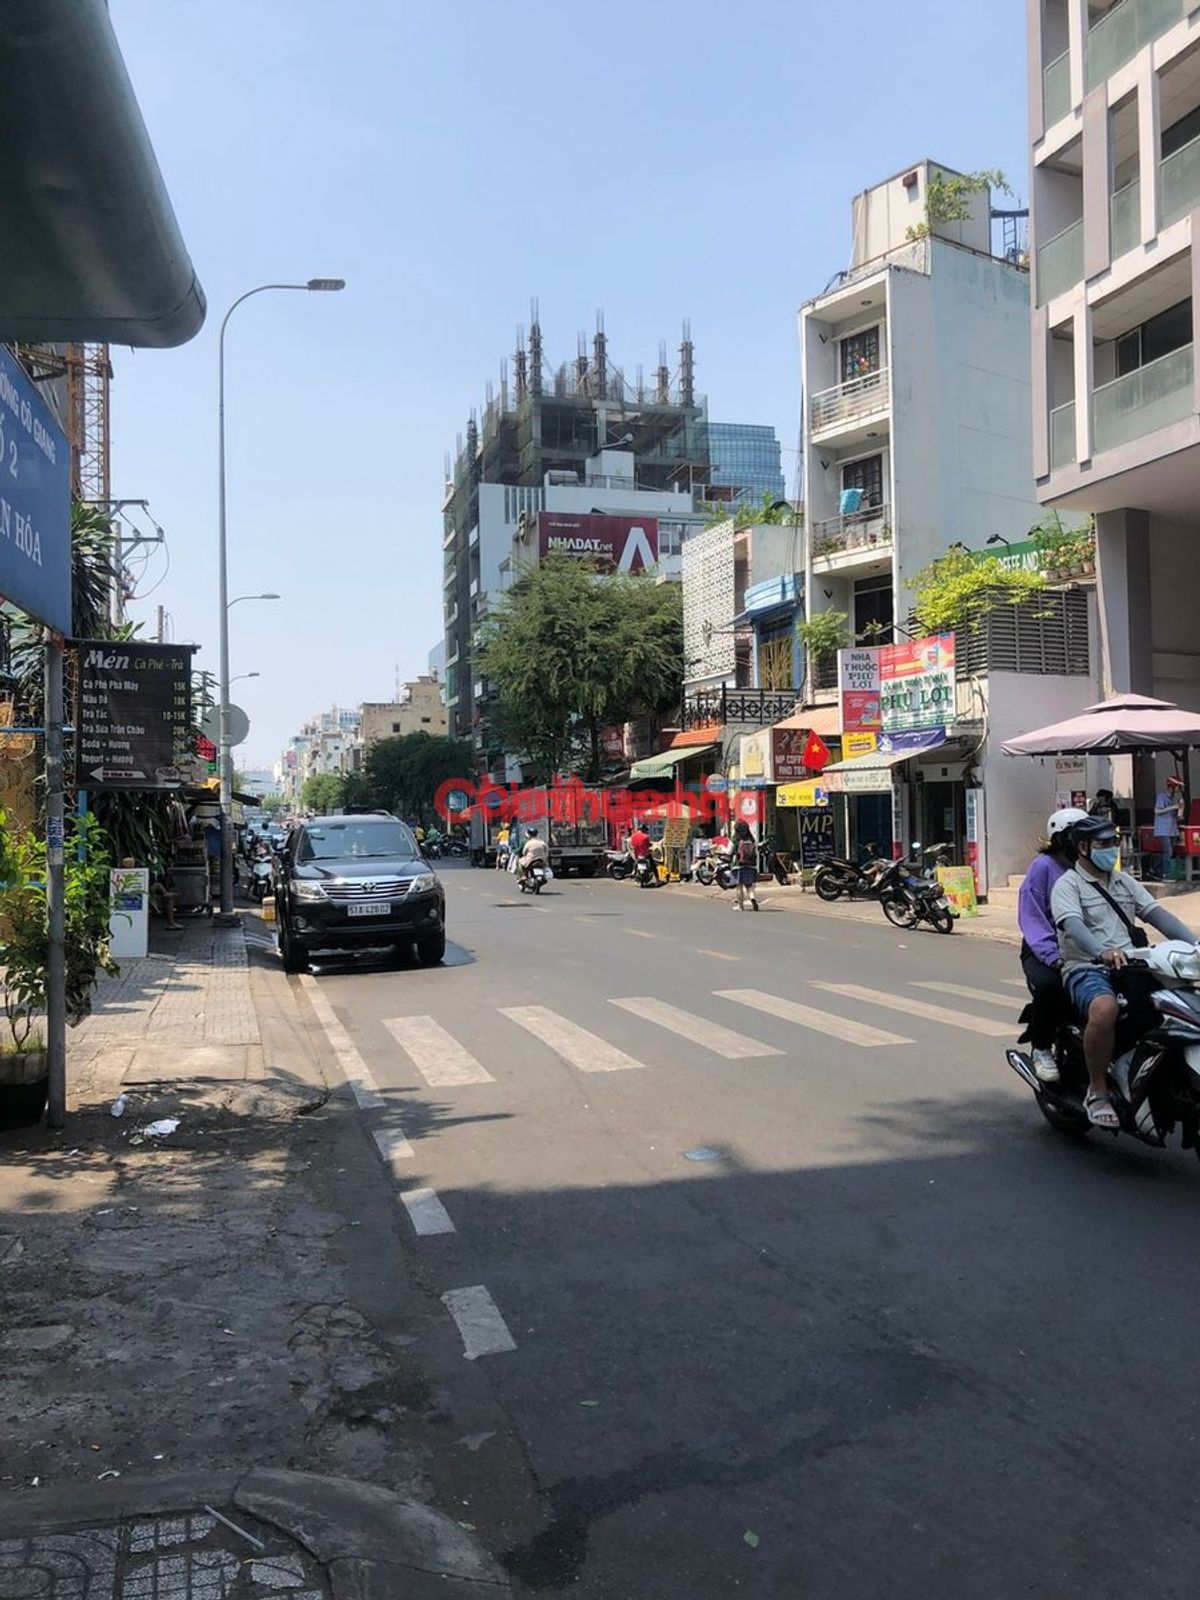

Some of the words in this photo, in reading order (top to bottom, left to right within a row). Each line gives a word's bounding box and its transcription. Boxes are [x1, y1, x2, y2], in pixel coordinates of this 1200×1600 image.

[9, 440, 18, 478] 2
[15, 514, 42, 566] HÓA
[802, 815, 833, 834] MP
